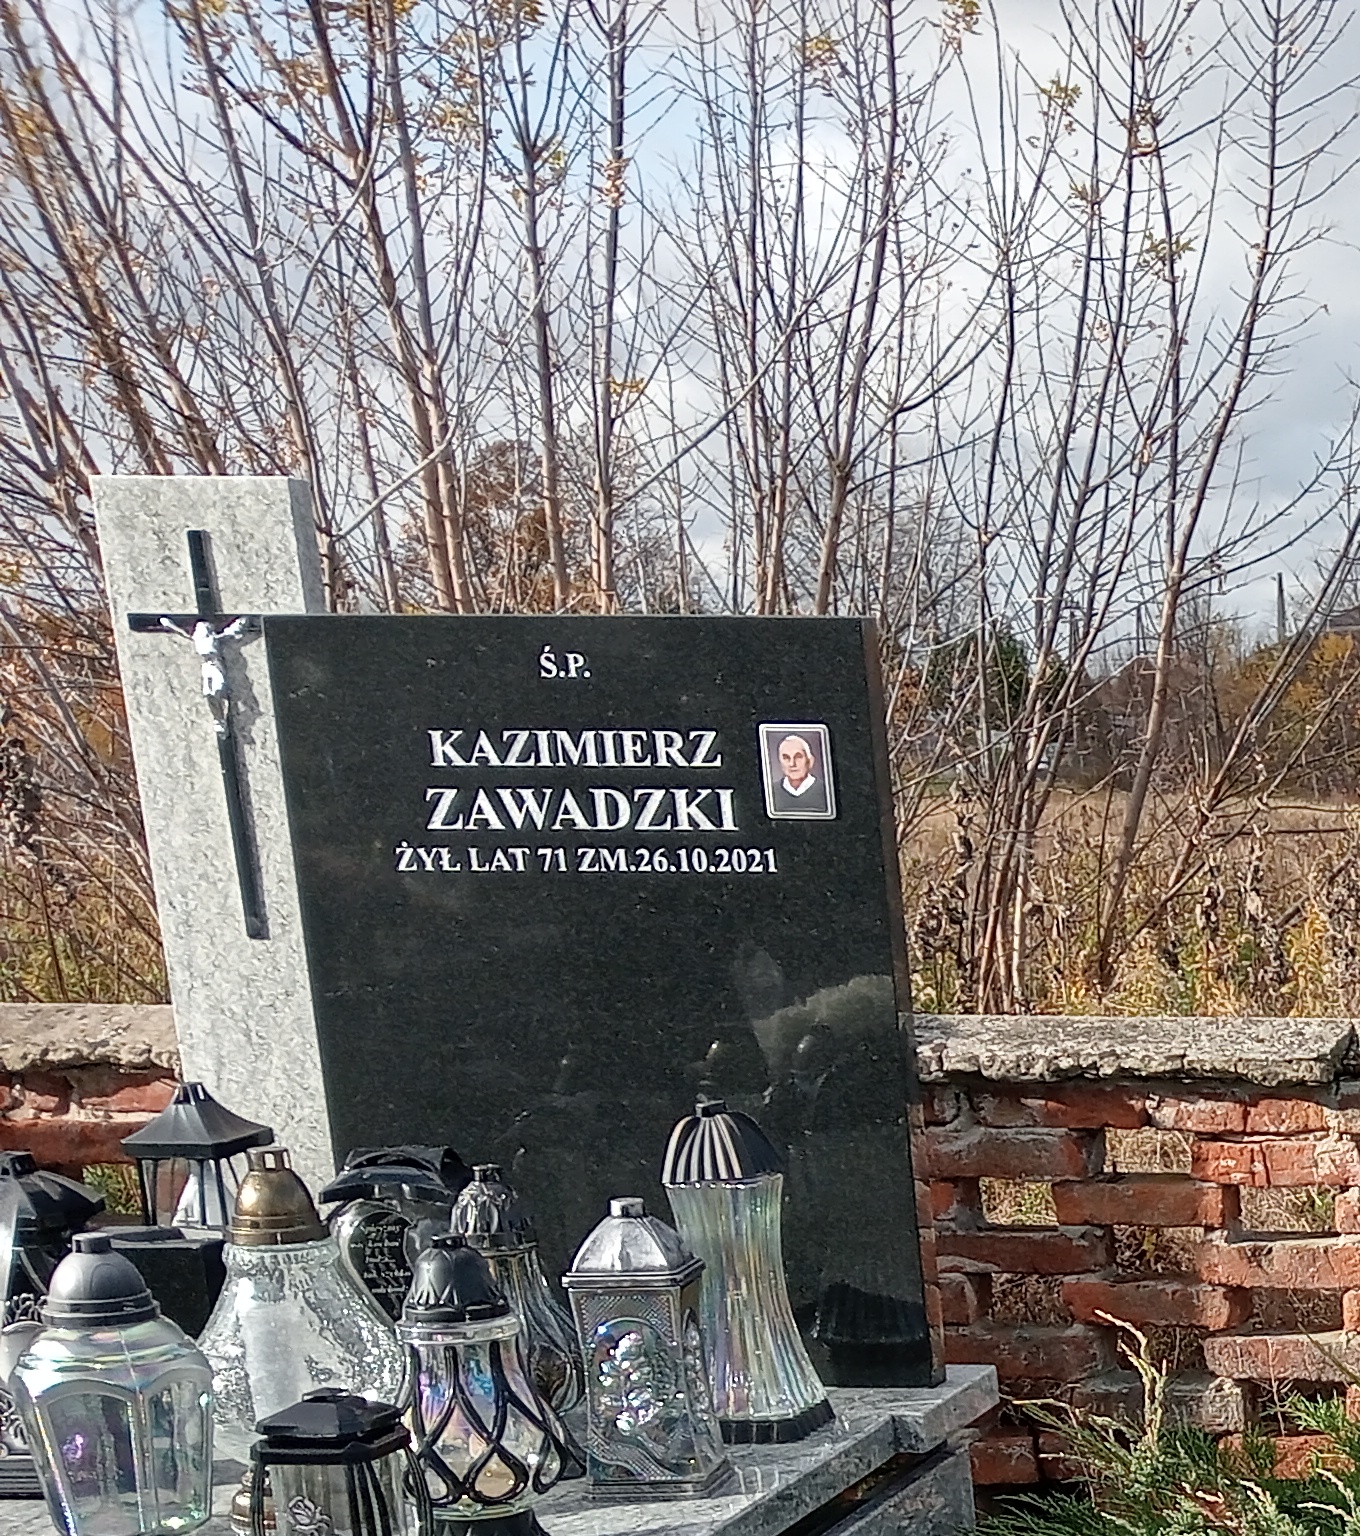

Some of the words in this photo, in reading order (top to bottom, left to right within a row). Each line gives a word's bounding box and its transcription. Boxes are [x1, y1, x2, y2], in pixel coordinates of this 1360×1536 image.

[539, 645, 591, 678] Ś.P.
[427, 729, 722, 767] KAZIMIERZ
[425, 788, 739, 831] ZAWADZKI
[395, 841, 461, 872] ŻYŁ
[468, 847, 530, 872] LAT
[537, 847, 568, 872] 71
